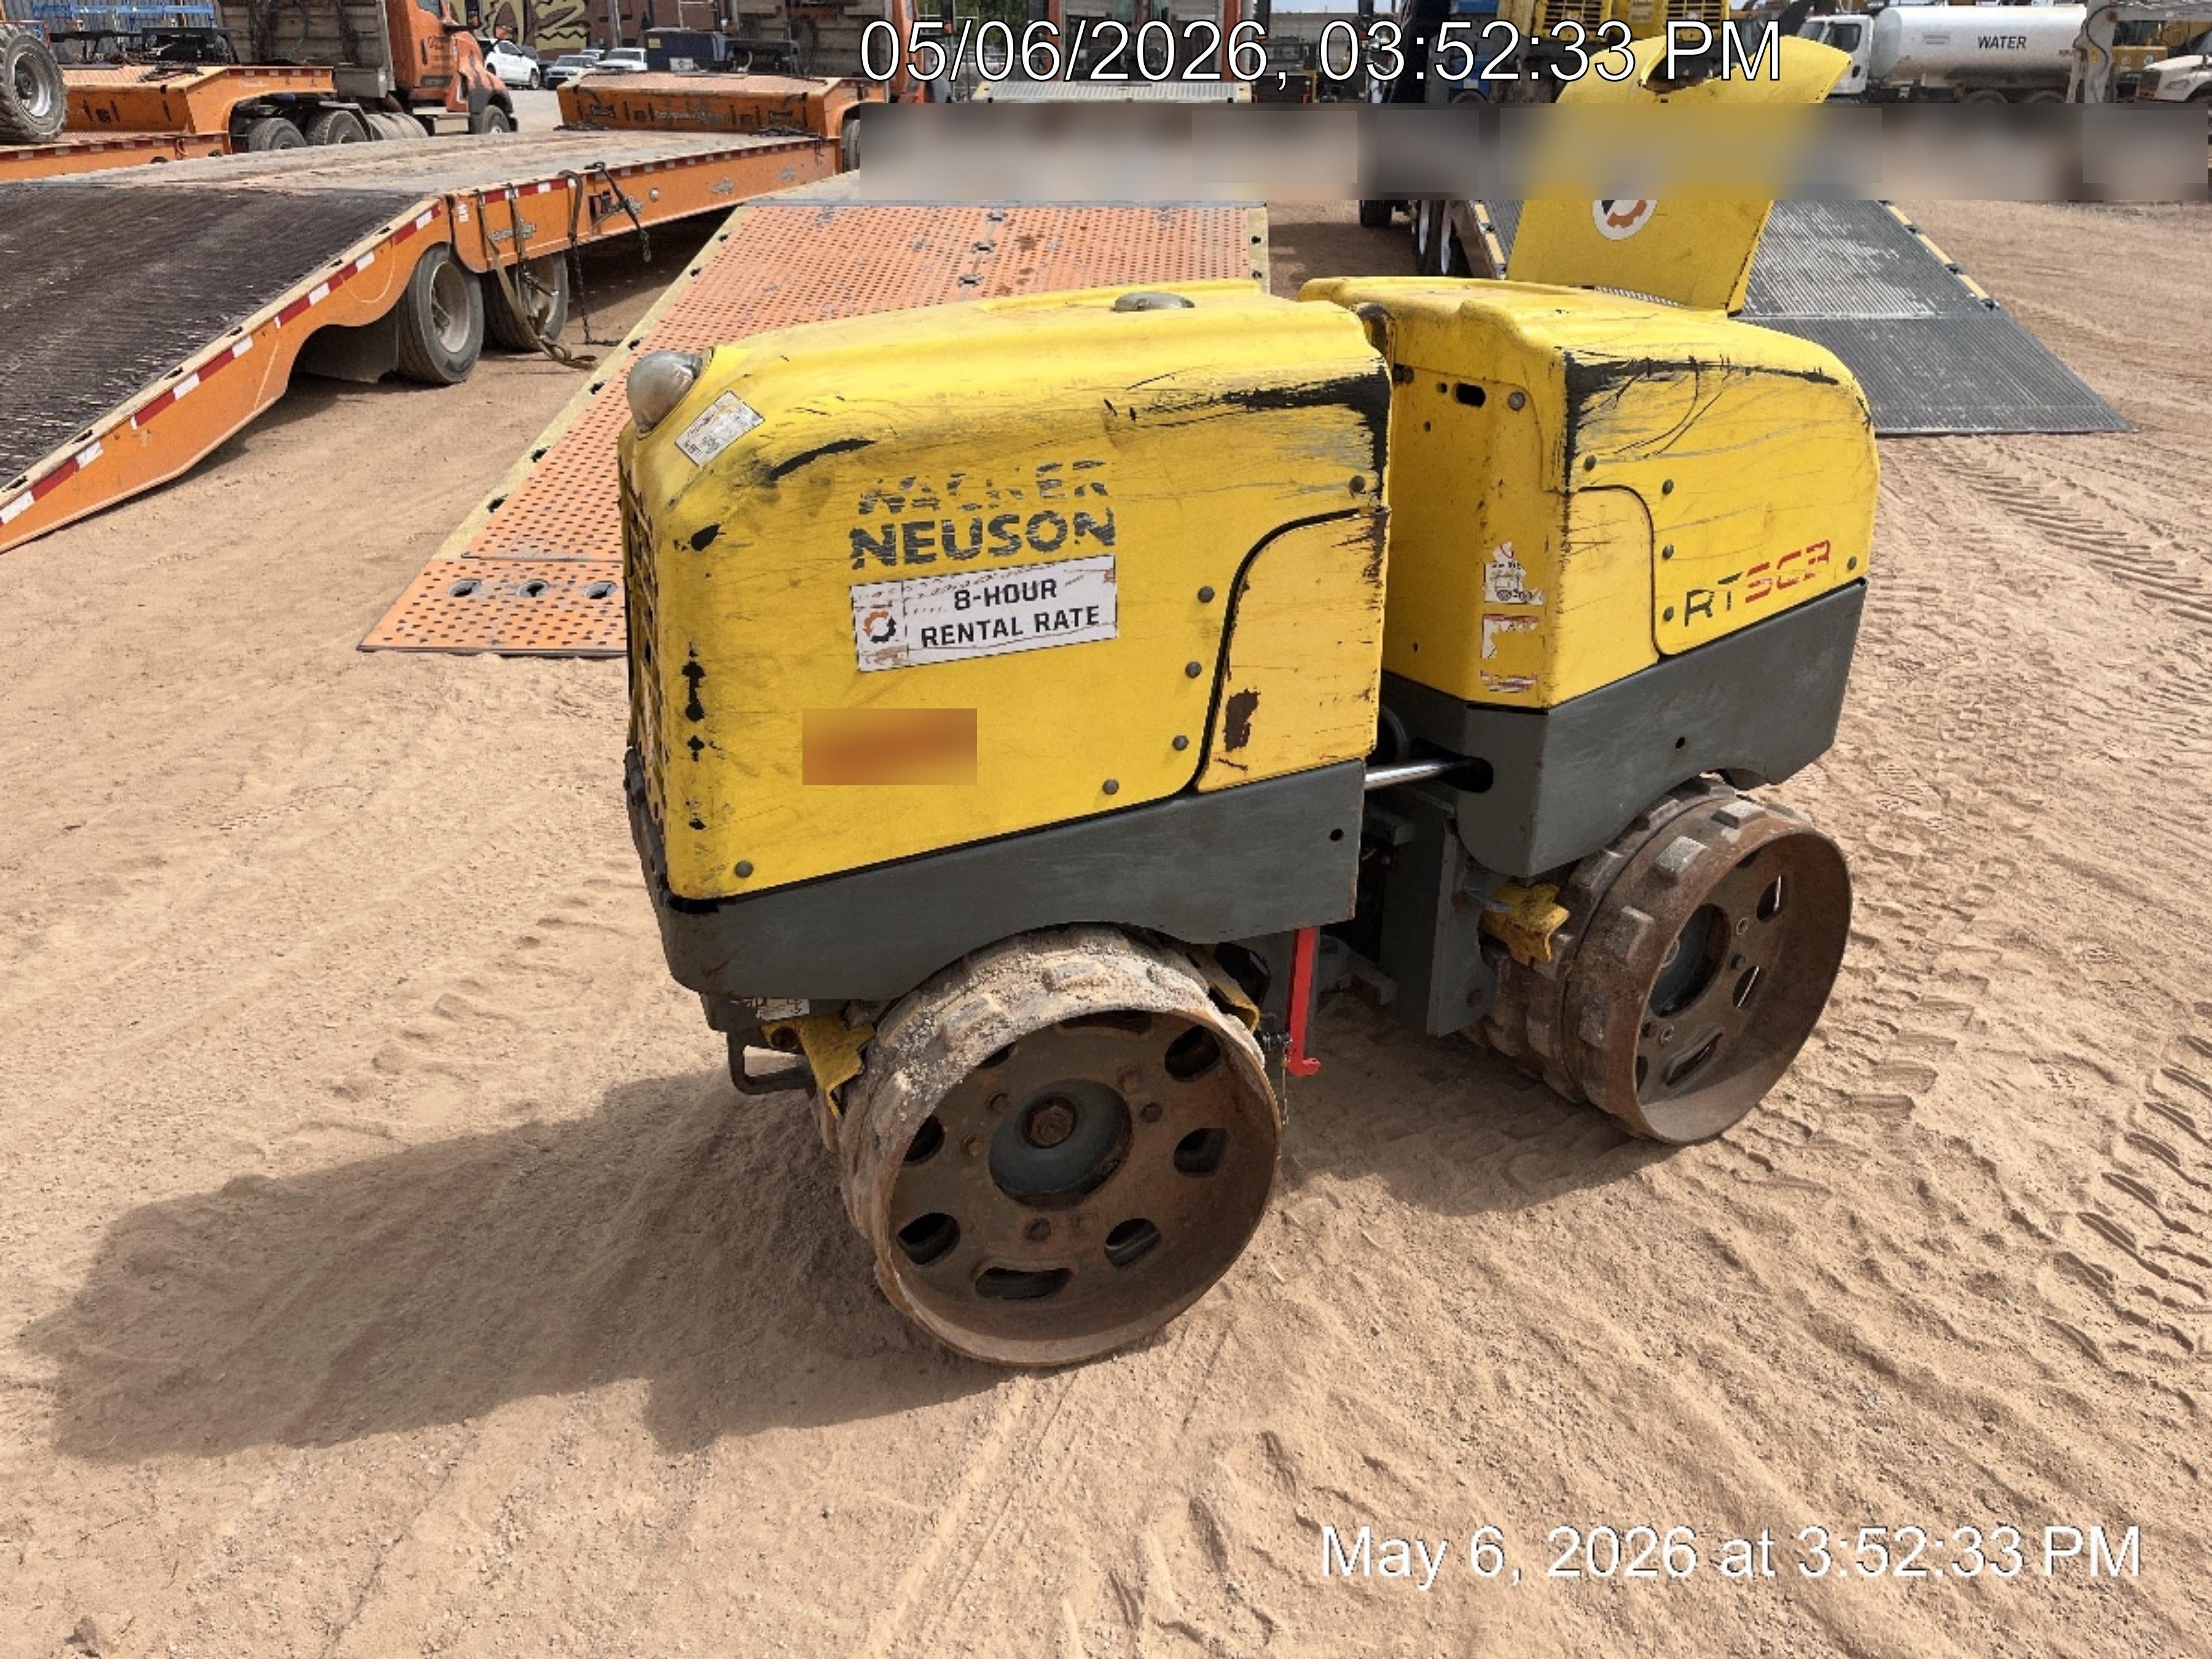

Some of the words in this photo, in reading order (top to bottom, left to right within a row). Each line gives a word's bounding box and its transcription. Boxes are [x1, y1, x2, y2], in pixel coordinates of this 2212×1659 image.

[1977, 36, 2027, 49] WATER
[849, 507, 1116, 570] NEUSON
[954, 578, 1057, 611] 8-HOUR
[920, 616, 1024, 648] RENTAL
[1034, 605, 1100, 633] RATE
